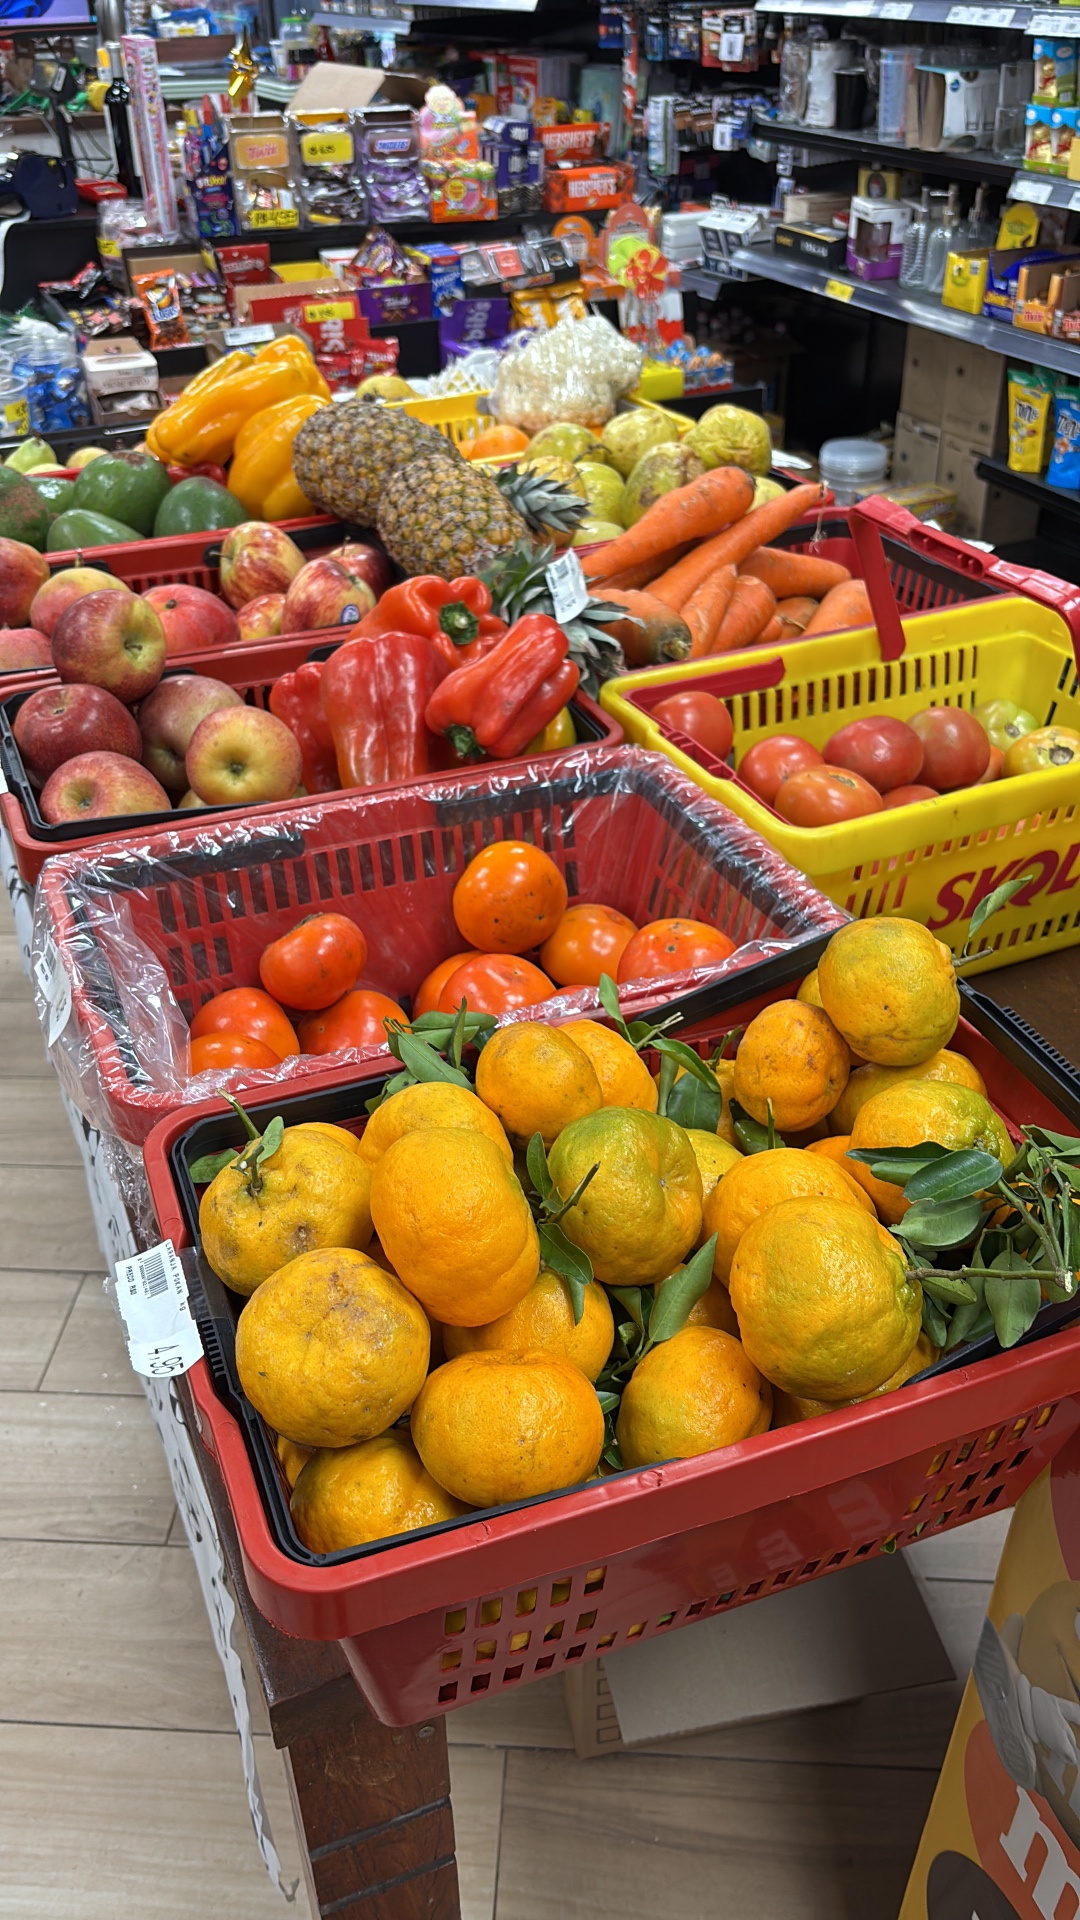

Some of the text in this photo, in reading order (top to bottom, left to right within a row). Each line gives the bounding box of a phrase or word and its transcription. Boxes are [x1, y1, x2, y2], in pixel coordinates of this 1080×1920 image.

[927, 843, 1080, 932] SKOL
[165, 1241, 187, 1312] LARANJA POKAN kg
[147, 1344, 185, 1375] 4,95
